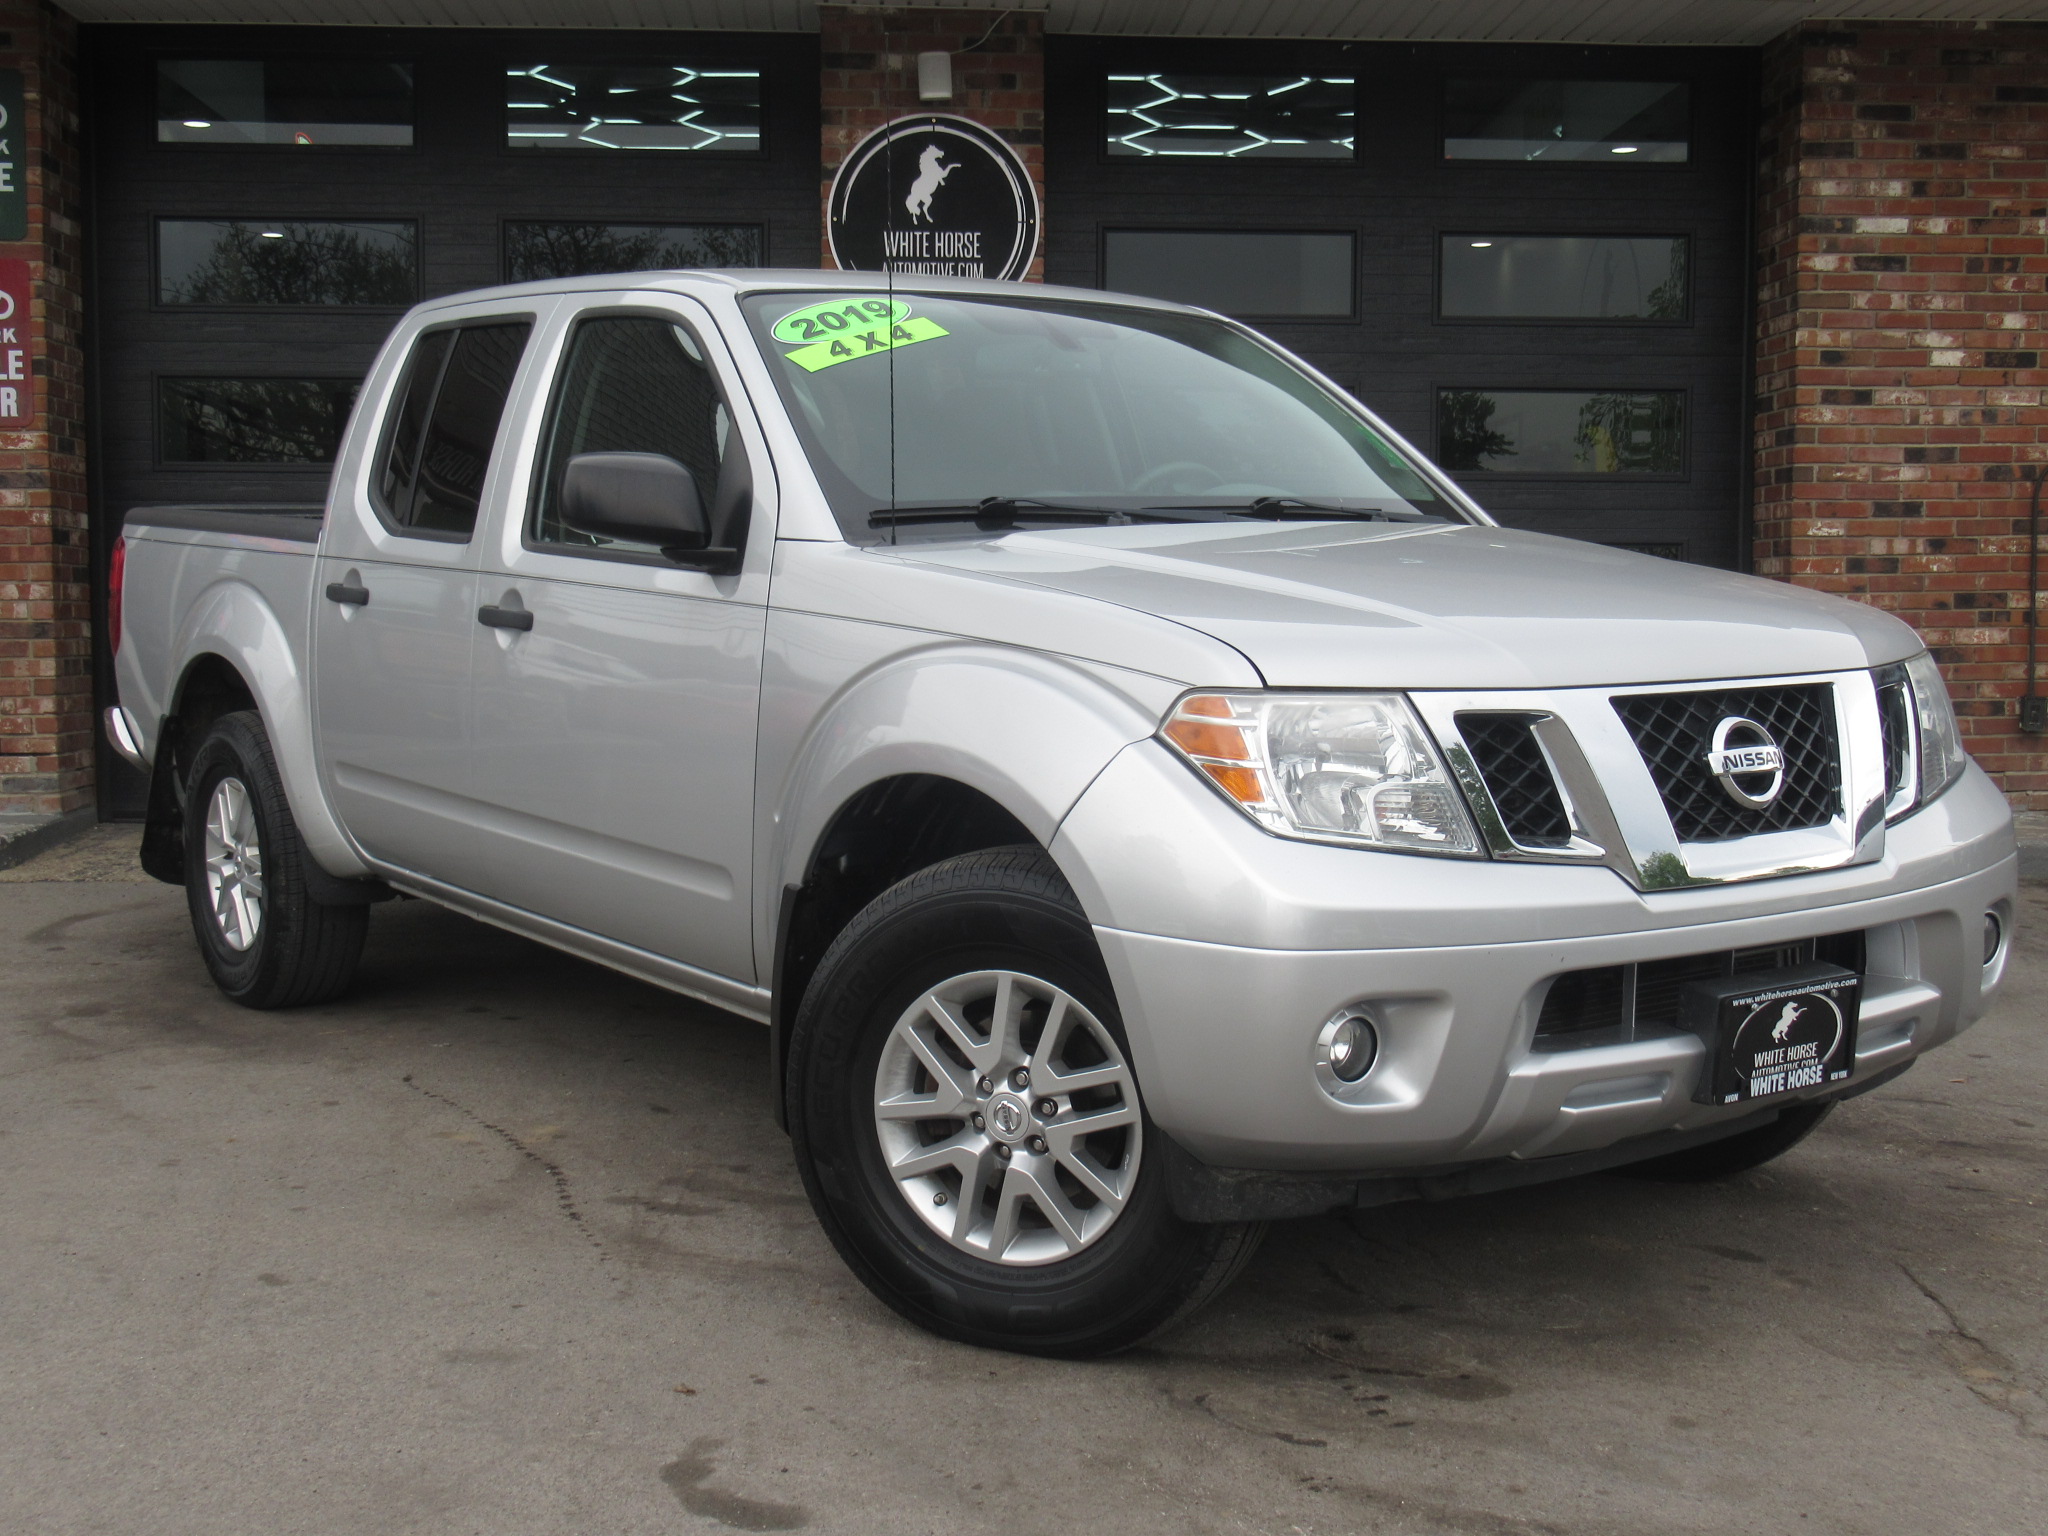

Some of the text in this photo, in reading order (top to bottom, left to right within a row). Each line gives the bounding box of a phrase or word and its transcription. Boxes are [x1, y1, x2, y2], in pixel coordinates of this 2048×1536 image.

[883, 231, 981, 258] WHITE HORSE
[790, 300, 896, 340] 2019
[1723, 751, 1782, 769] NISSAN
[1732, 978, 1857, 1007] www.whitehorseautomotive.com
[1754, 1041, 1818, 1068] WHITE HORSE
[1750, 1064, 1823, 1097] WHITE HORSE
[1830, 1070, 1848, 1081] NEW YORK
[1724, 1093, 1739, 1104] AVON
